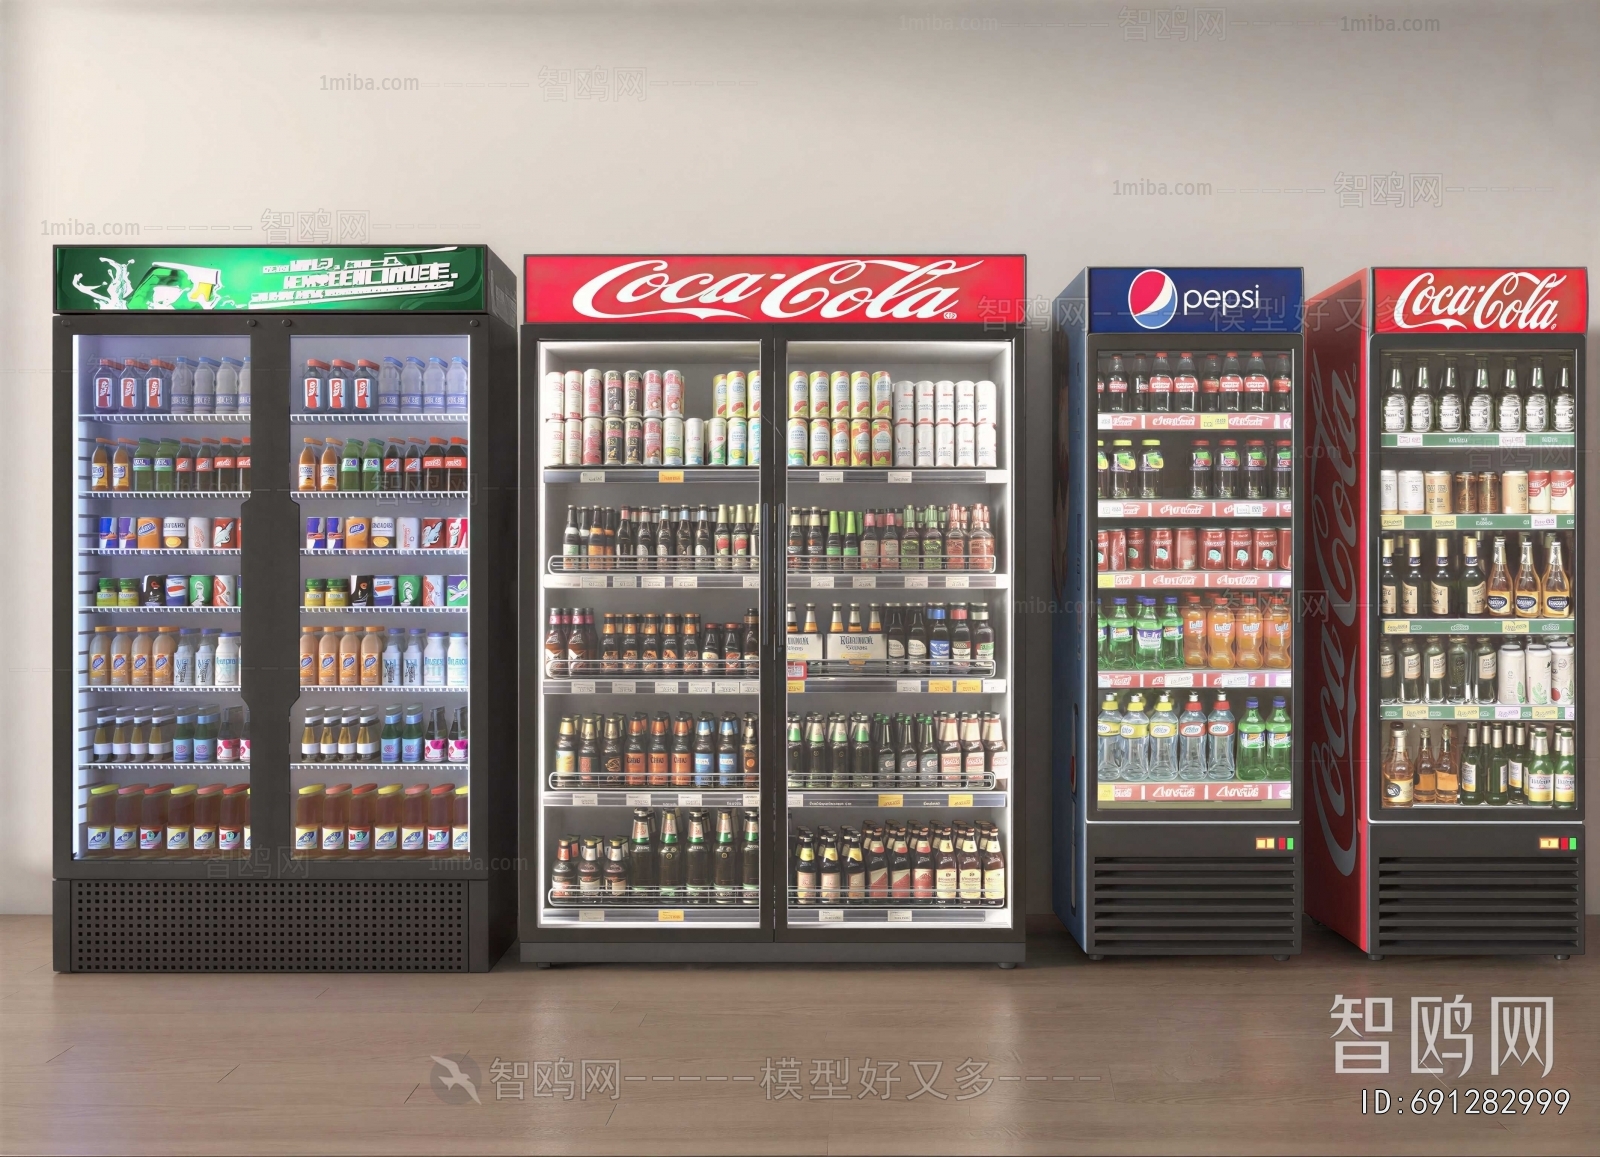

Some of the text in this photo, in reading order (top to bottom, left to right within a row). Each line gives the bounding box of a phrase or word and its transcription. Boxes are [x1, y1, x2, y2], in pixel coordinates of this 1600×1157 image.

[572, 258, 985, 321] Coca-Cola
[1183, 284, 1260, 316] pepsi
[1392, 271, 1567, 331] Coca-Cola
